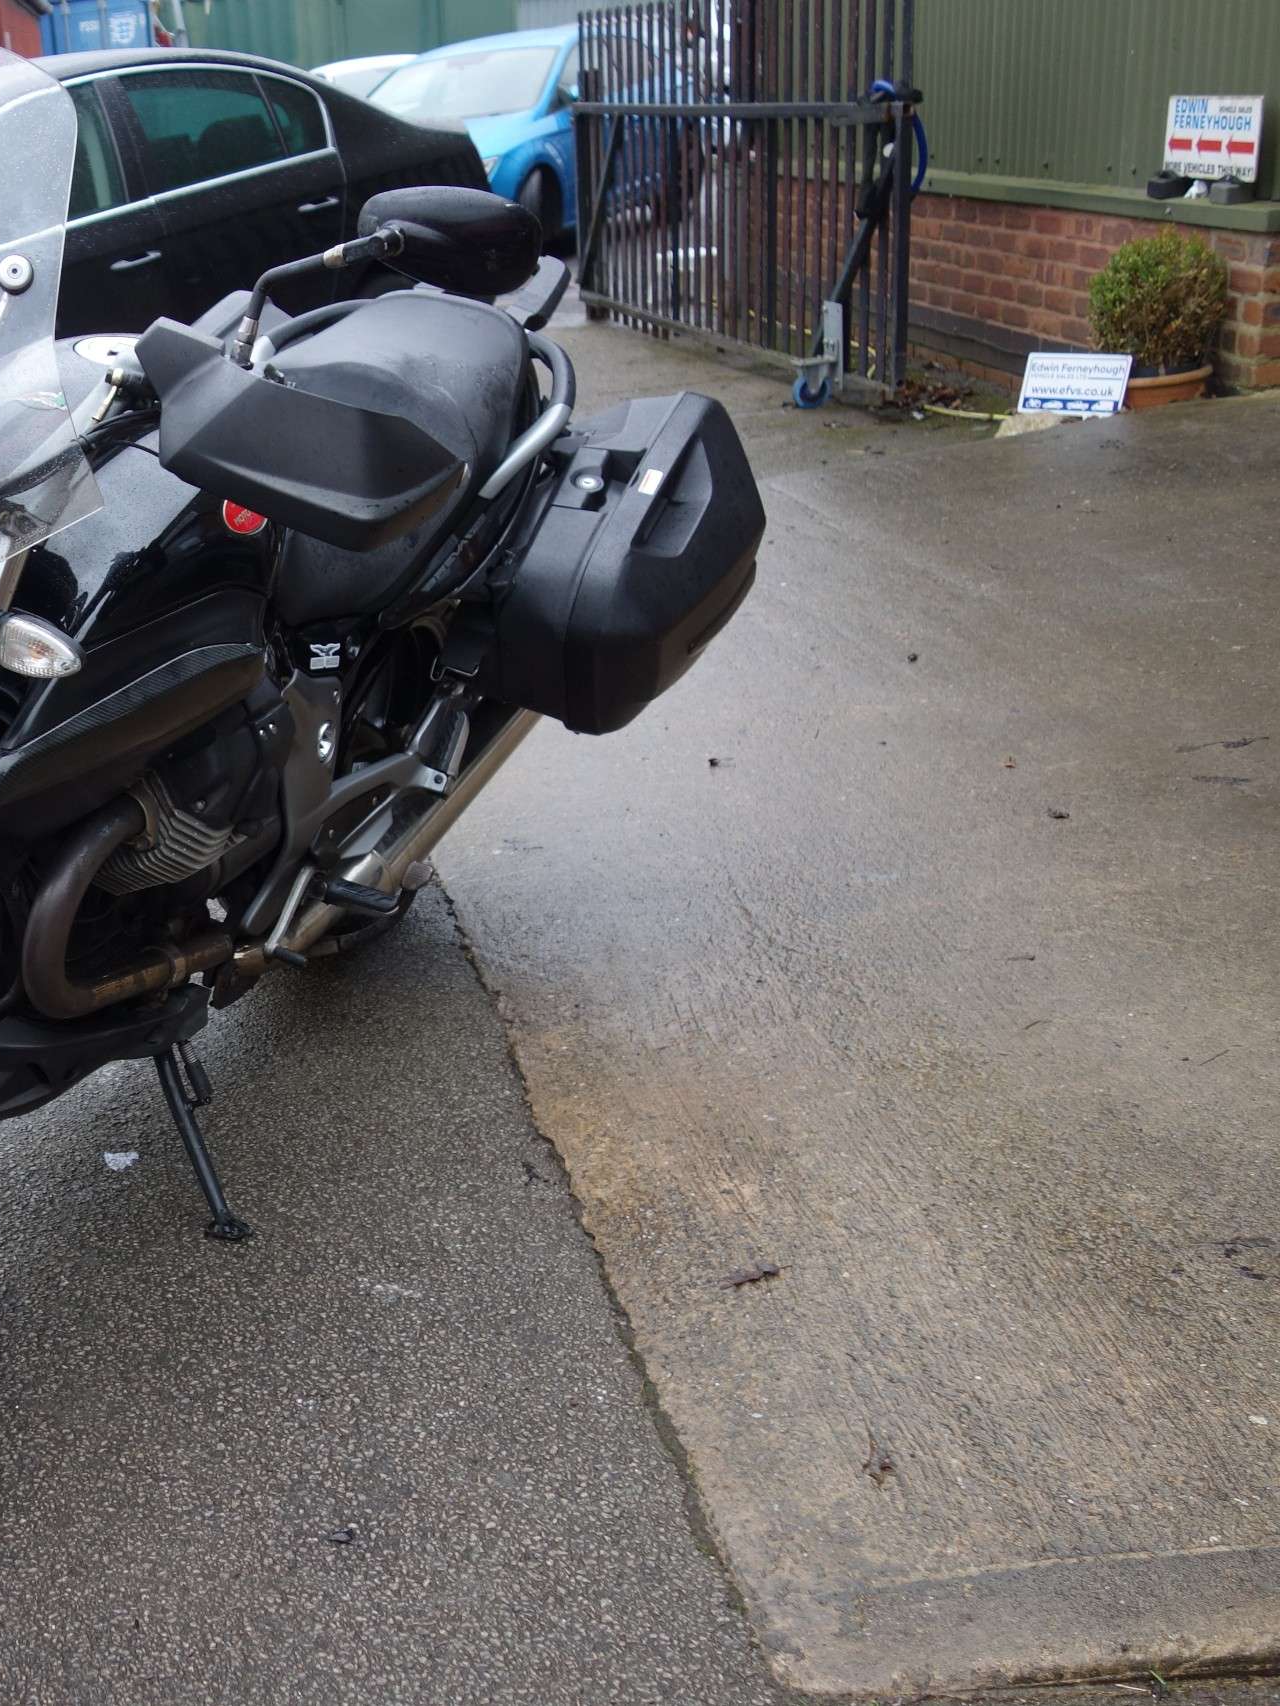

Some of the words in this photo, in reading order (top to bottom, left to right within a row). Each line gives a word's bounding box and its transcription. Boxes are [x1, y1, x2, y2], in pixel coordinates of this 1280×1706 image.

[1175, 98, 1208, 113] EDWIN
[1173, 115, 1252, 131] FERNEYHOUGH
[1183, 163, 1216, 175] VEHICLES
[1031, 362, 1059, 373] Edwin
[1061, 363, 1127, 375] Ferneyhough
[1031, 384, 1114, 397] www.efvs.co.uk
